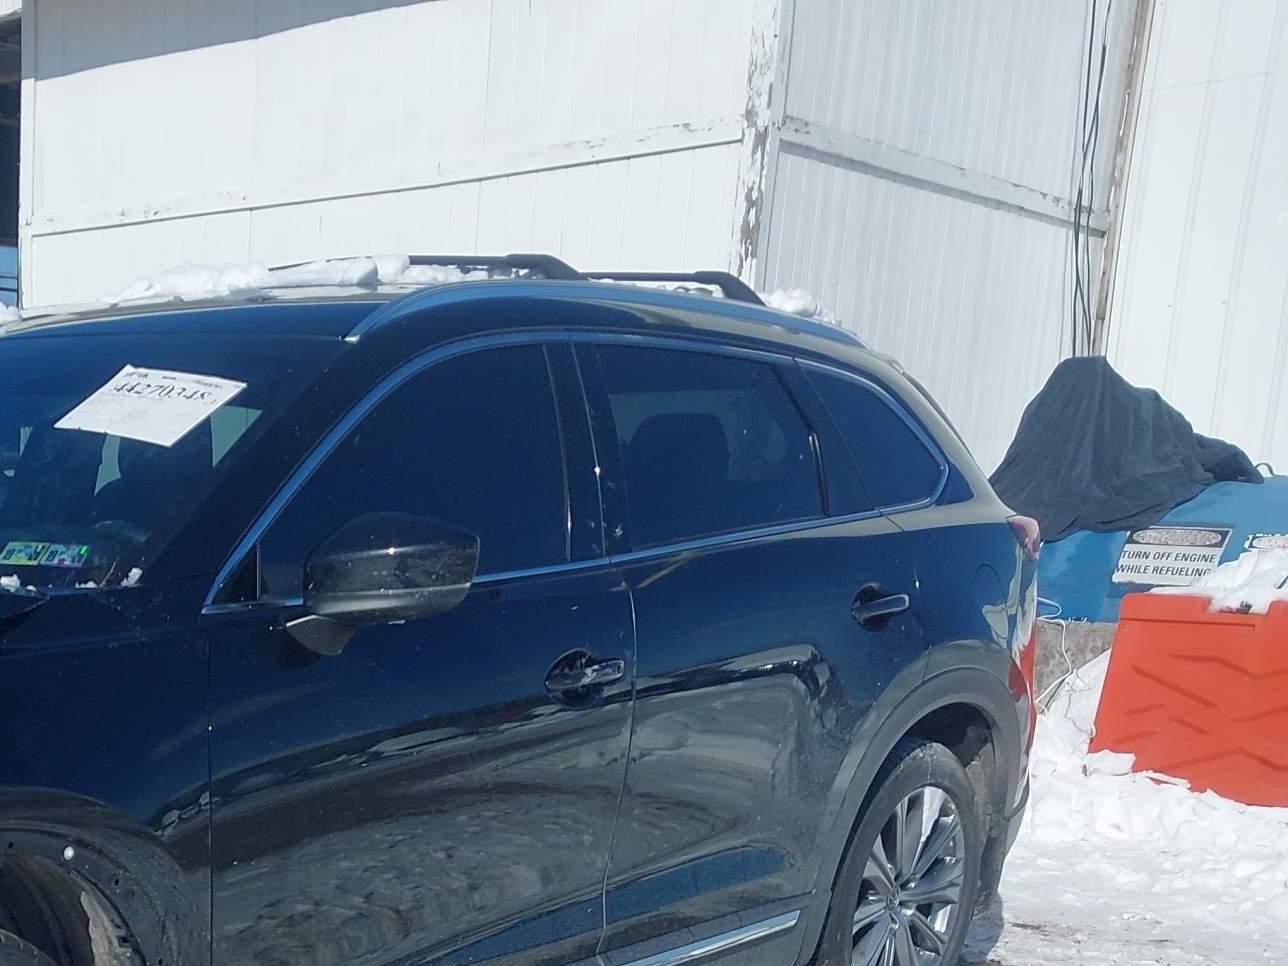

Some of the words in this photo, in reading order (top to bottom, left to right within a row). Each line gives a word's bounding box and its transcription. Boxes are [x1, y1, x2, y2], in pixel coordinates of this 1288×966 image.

[1122, 550, 1150, 560] TURN
[1153, 552, 1173, 561] OFF
[1175, 552, 1217, 563] ENGINE
[1117, 564, 1150, 574] WHILE
